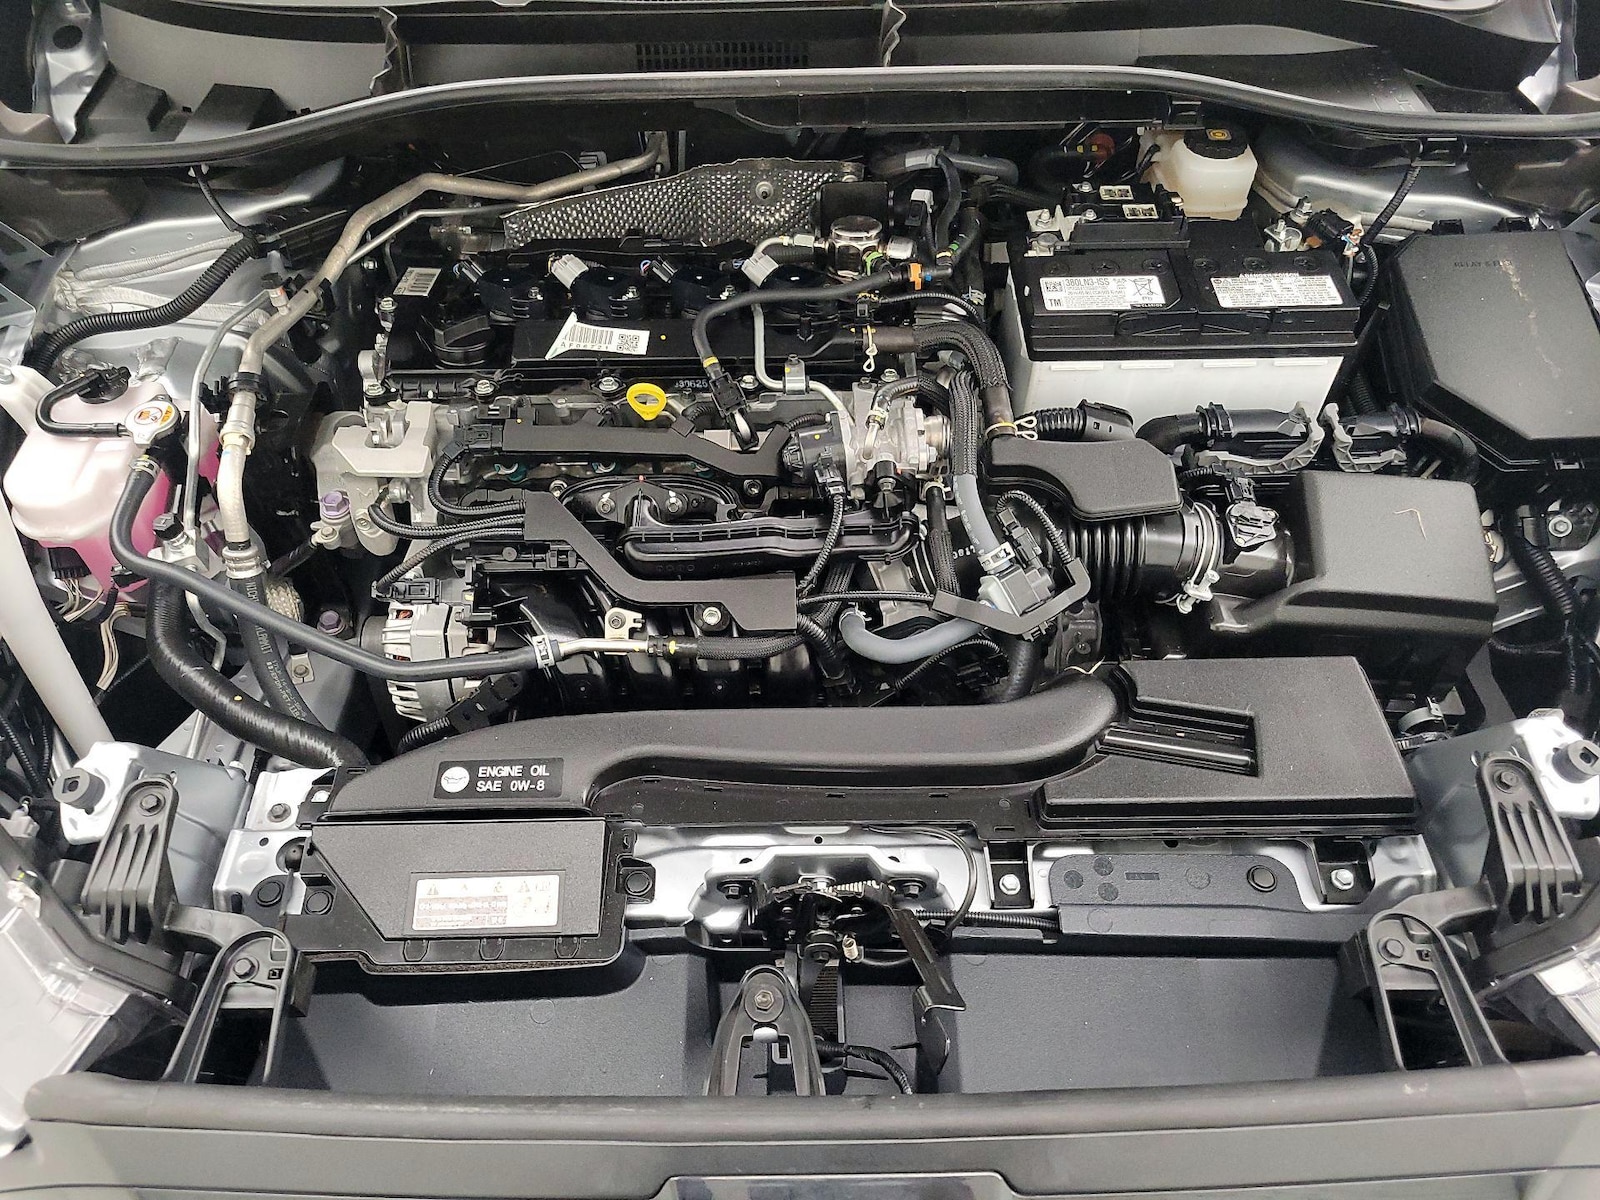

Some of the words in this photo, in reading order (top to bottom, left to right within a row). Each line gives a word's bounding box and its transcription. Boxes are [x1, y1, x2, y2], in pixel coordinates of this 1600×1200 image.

[1049, 298, 1062, 307] TM
[477, 765, 524, 778] ENGINE
[530, 764, 550, 777] OIL
[475, 780, 502, 792] SAE
[510, 780, 545, 792] 0W-8
